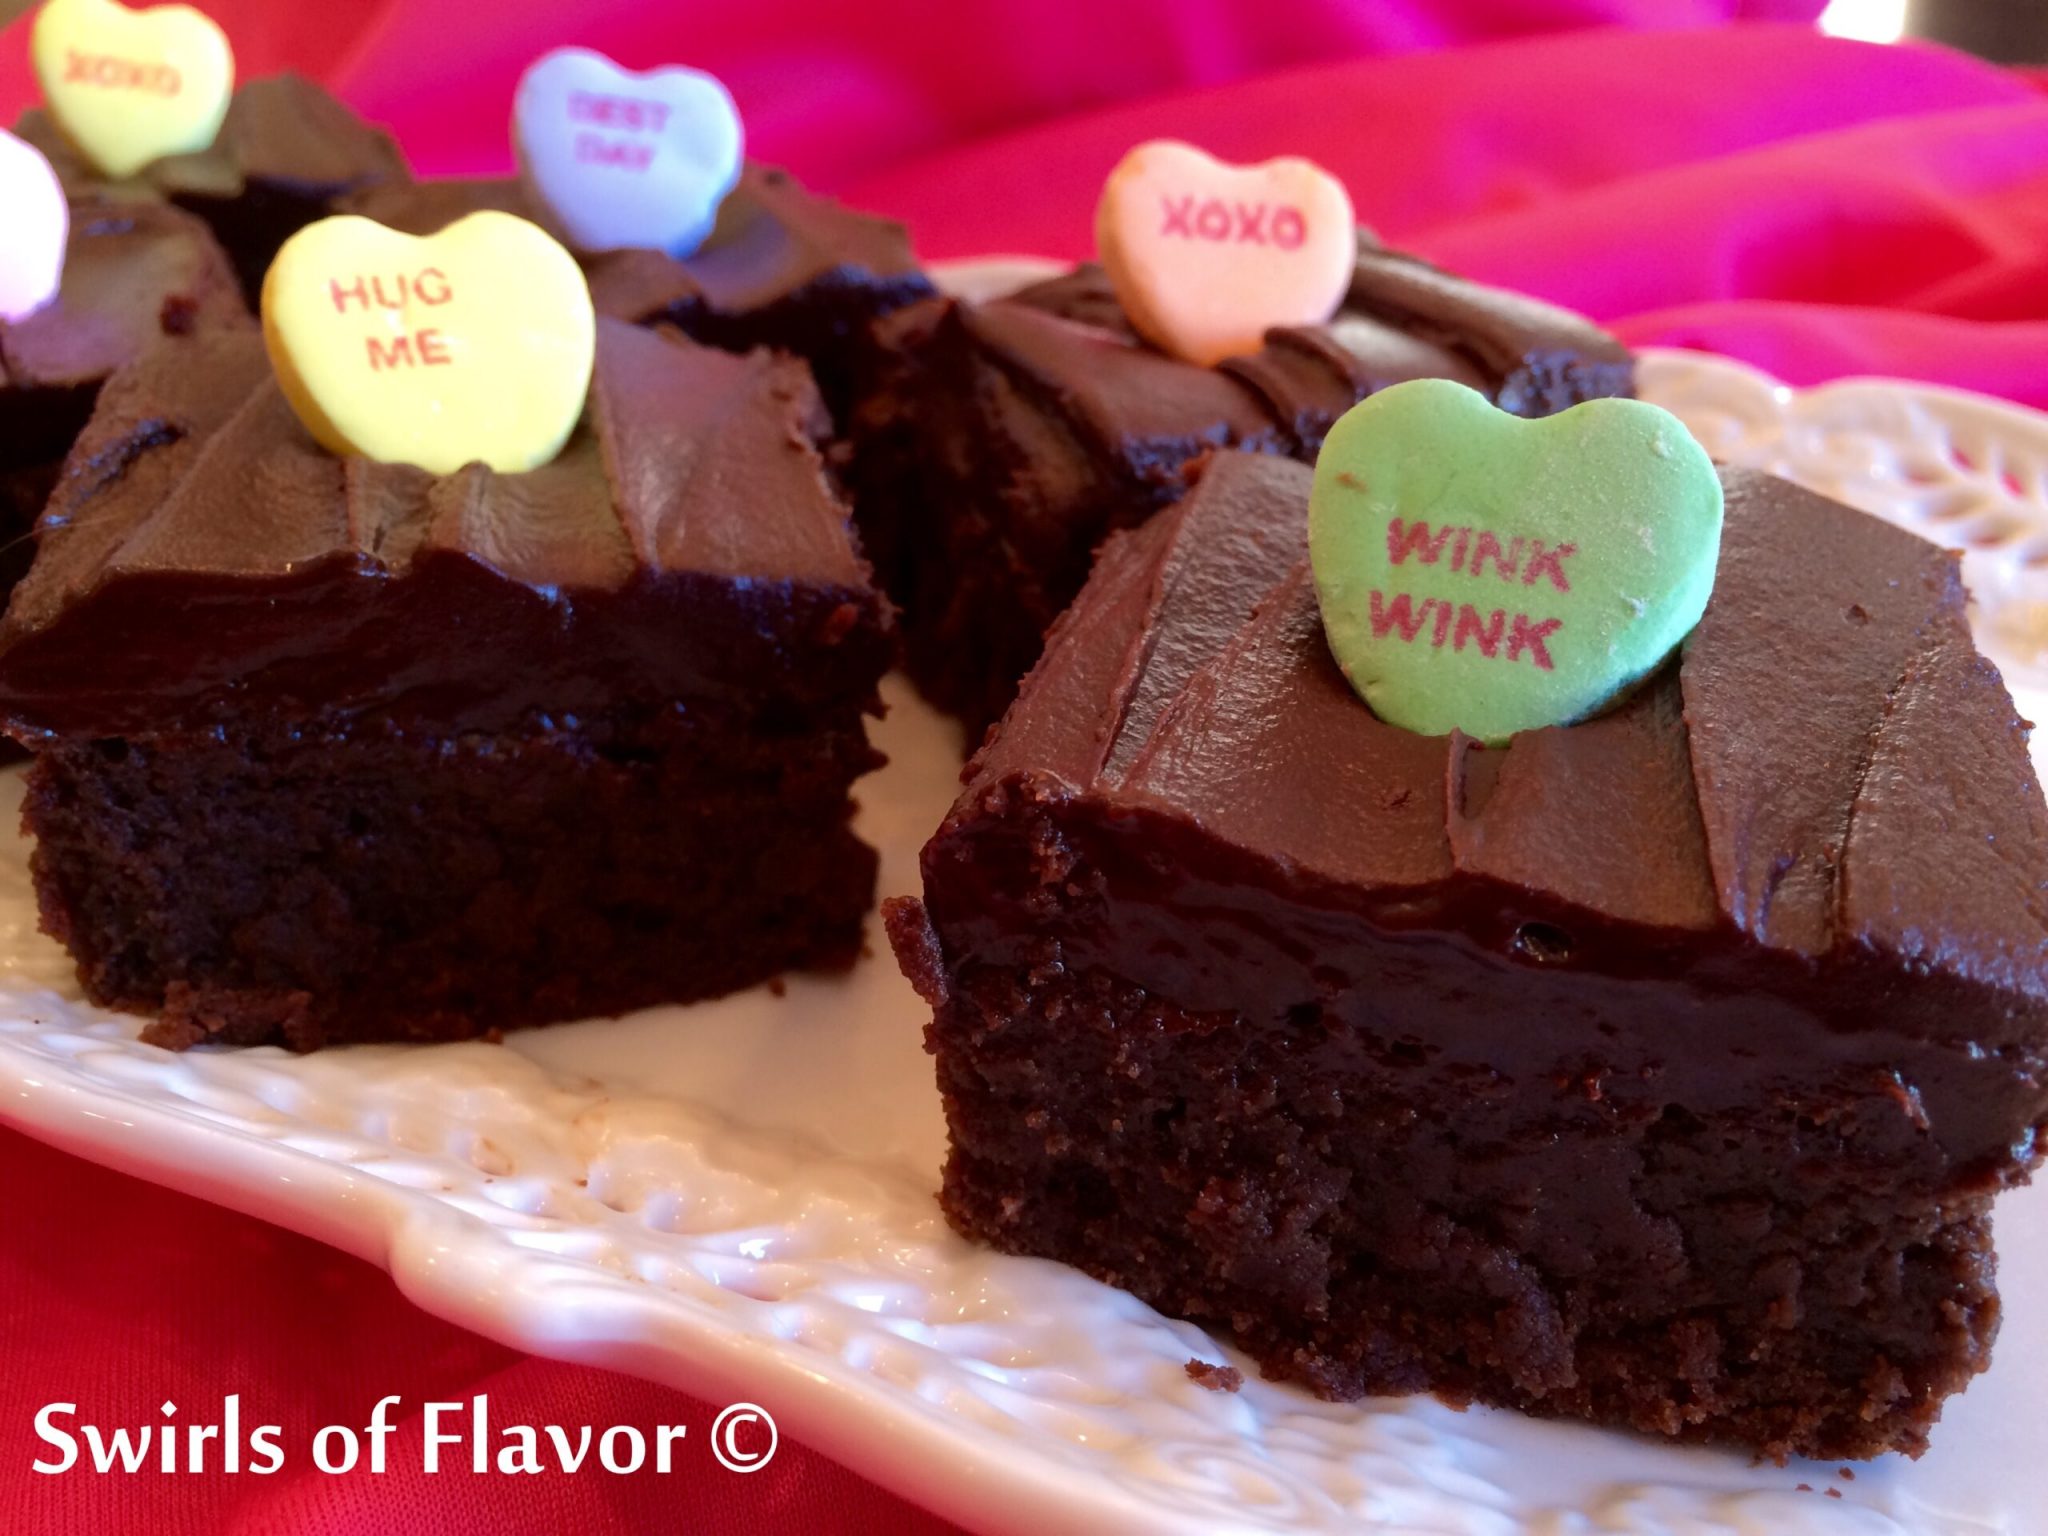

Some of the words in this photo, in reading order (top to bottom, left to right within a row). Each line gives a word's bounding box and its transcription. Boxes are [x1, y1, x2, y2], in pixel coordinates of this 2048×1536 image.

[63, 47, 183, 99] XOXO
[1160, 194, 1308, 251] XOXO
[330, 268, 453, 313] HUG
[366, 329, 451, 372] ME
[1387, 516, 1578, 592] WINK
[1369, 590, 1563, 670] WINK
